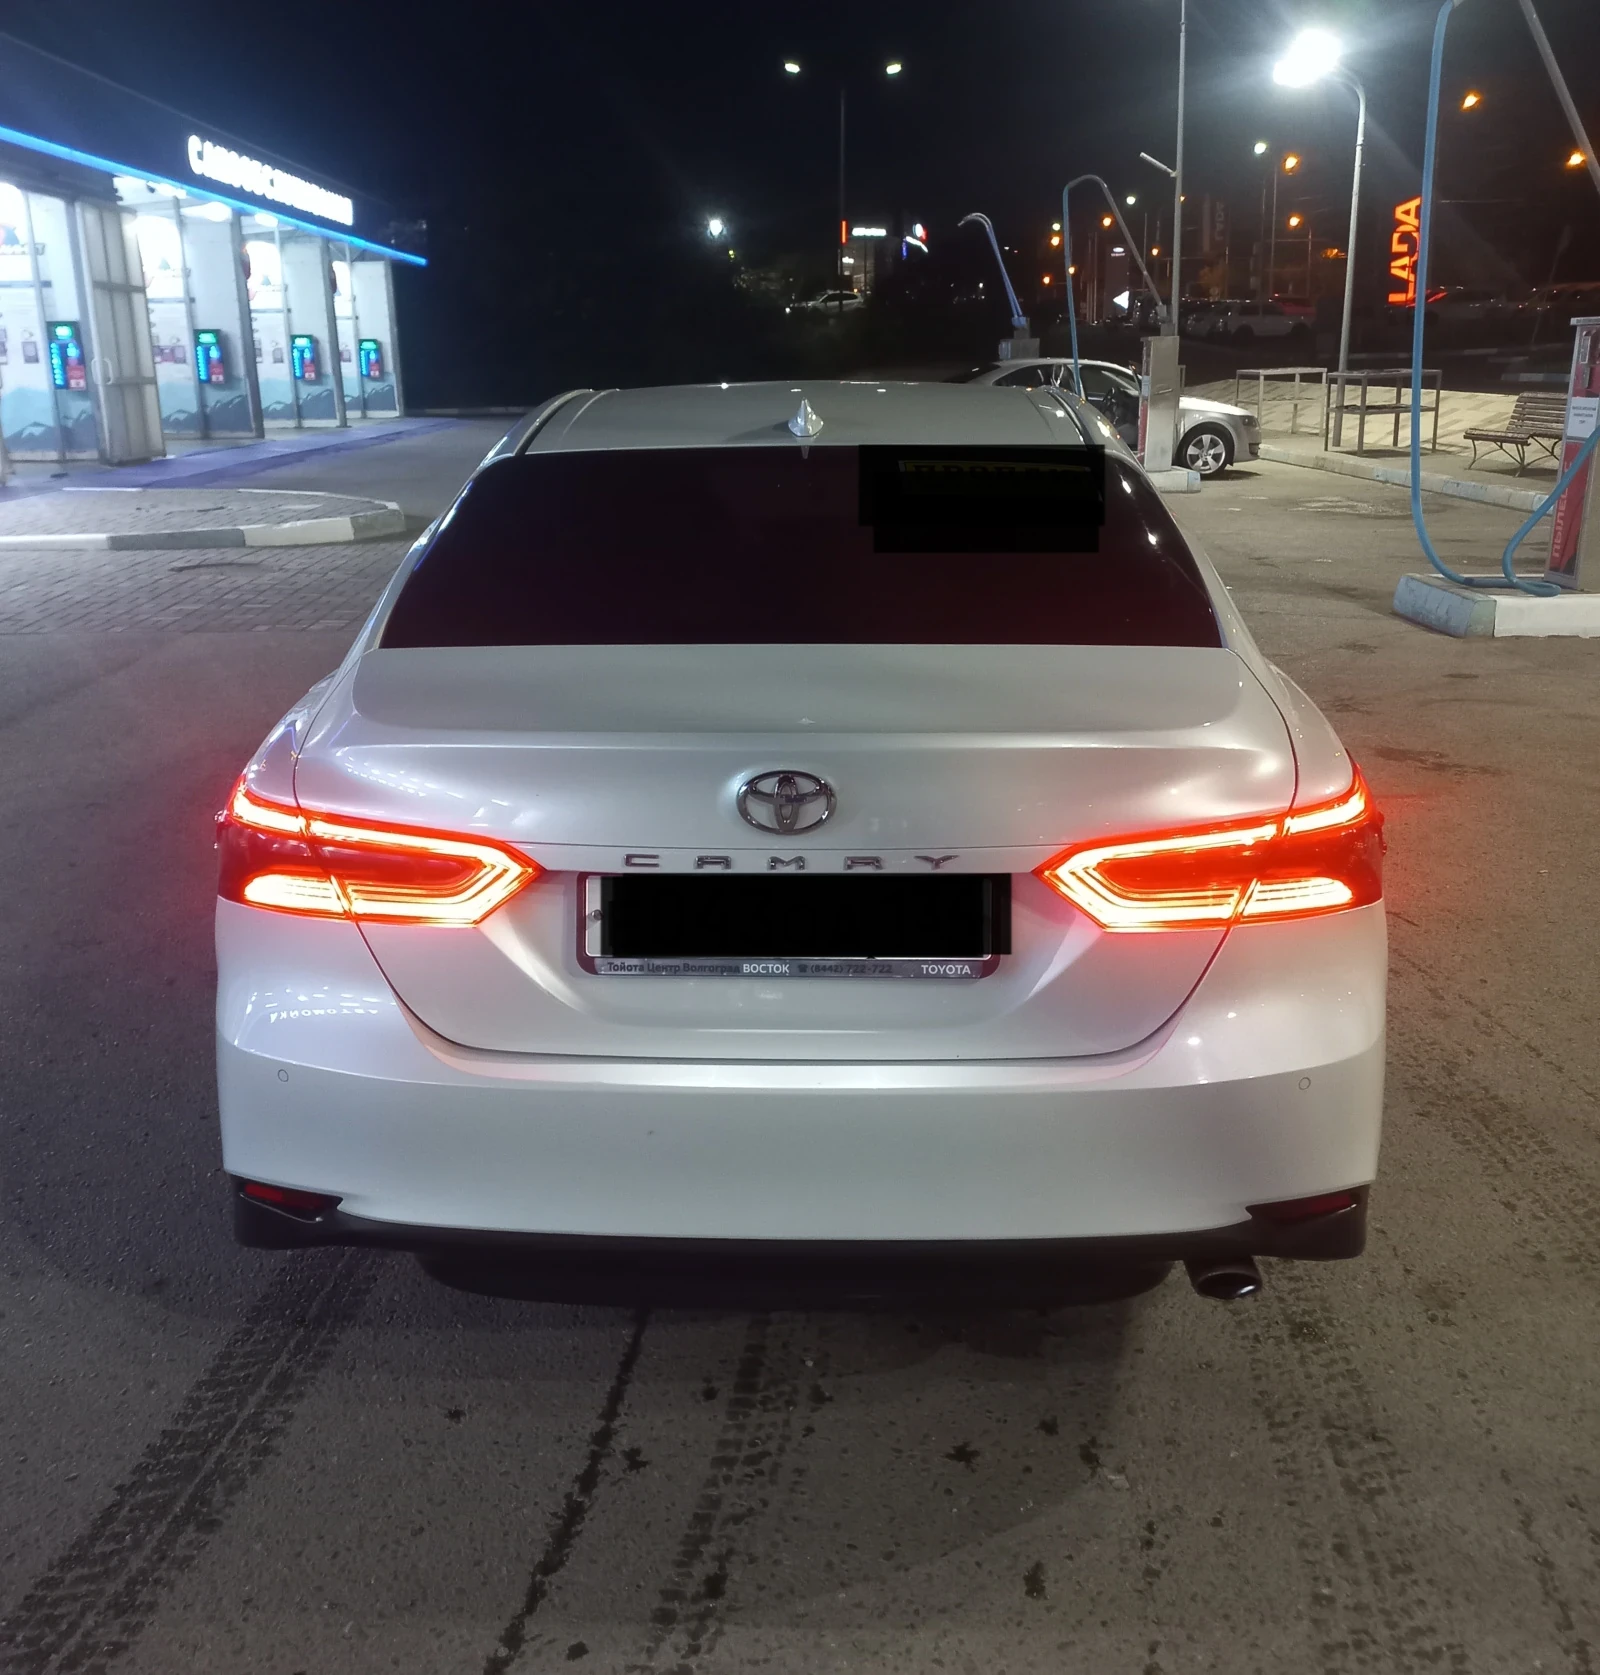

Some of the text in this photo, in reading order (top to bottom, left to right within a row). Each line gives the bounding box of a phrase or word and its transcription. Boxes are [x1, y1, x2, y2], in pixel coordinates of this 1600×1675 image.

[1388, 196, 1421, 303] LADA
[1552, 460, 1573, 558] ПЫЛЕСС
[623, 853, 959, 872] CAMRY
[607, 961, 893, 975] Тойота Центр Волгоград ВОСТОК (8442) 722-722
[921, 964, 971, 975] TOYOTA
